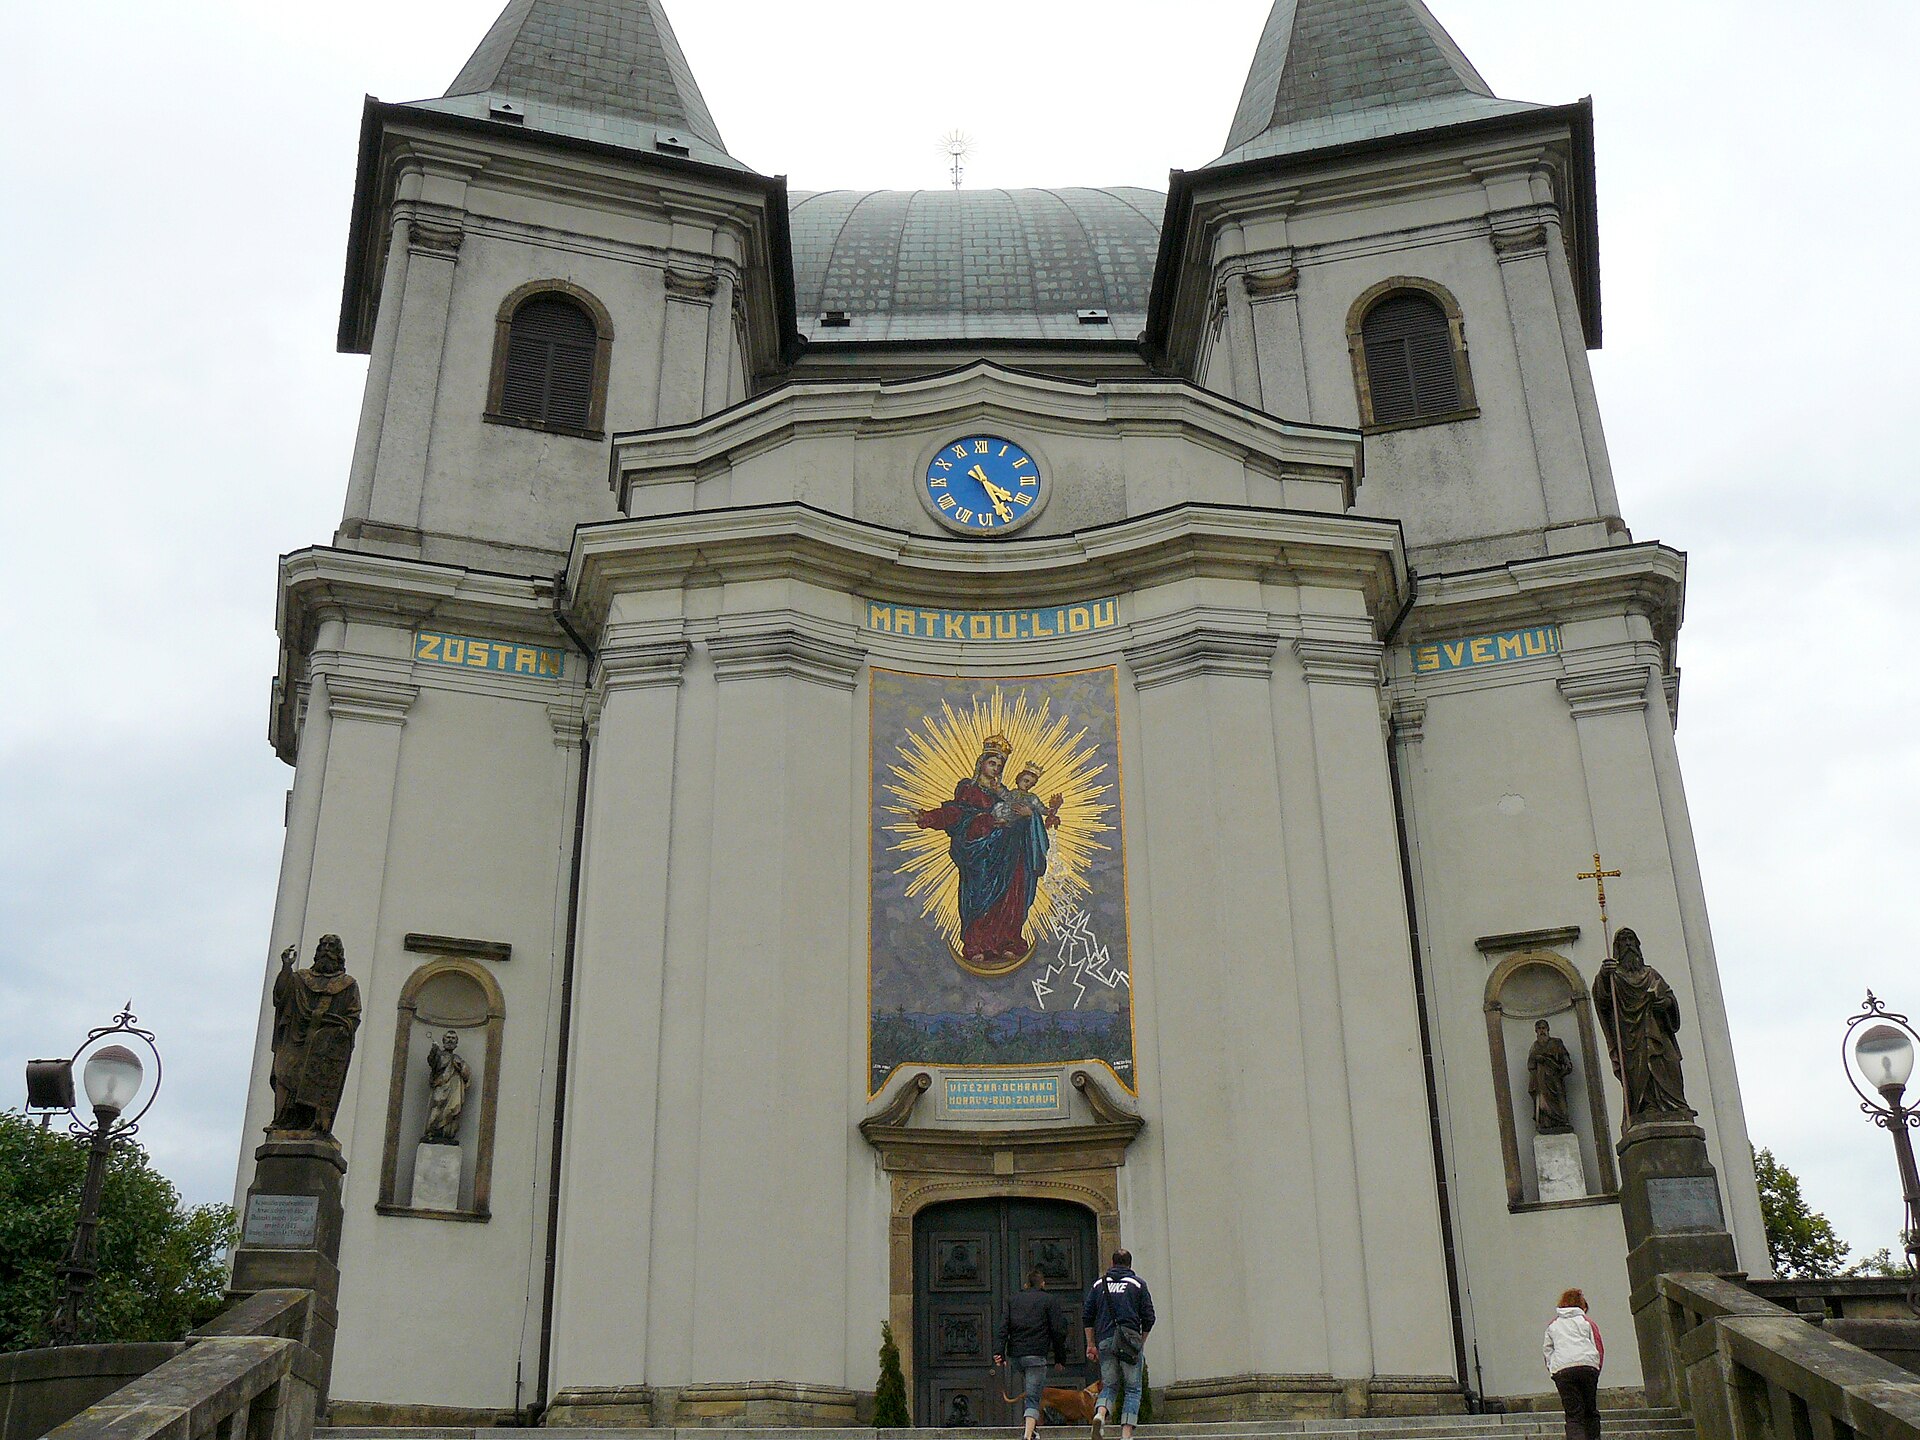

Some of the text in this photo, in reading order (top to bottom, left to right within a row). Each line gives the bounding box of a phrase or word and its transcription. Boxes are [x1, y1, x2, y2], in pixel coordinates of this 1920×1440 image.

[951, 444, 968, 459] XI
[974, 440, 989, 454] XII
[998, 445, 1009, 457] I
[935, 457, 953, 471] X
[1012, 456, 1029, 469] II
[930, 477, 947, 487] IX
[1019, 475, 1037, 486] III
[937, 492, 957, 511] VIII
[1013, 491, 1033, 507] IIII
[955, 506, 973, 524] VII
[977, 512, 994, 527] VI
